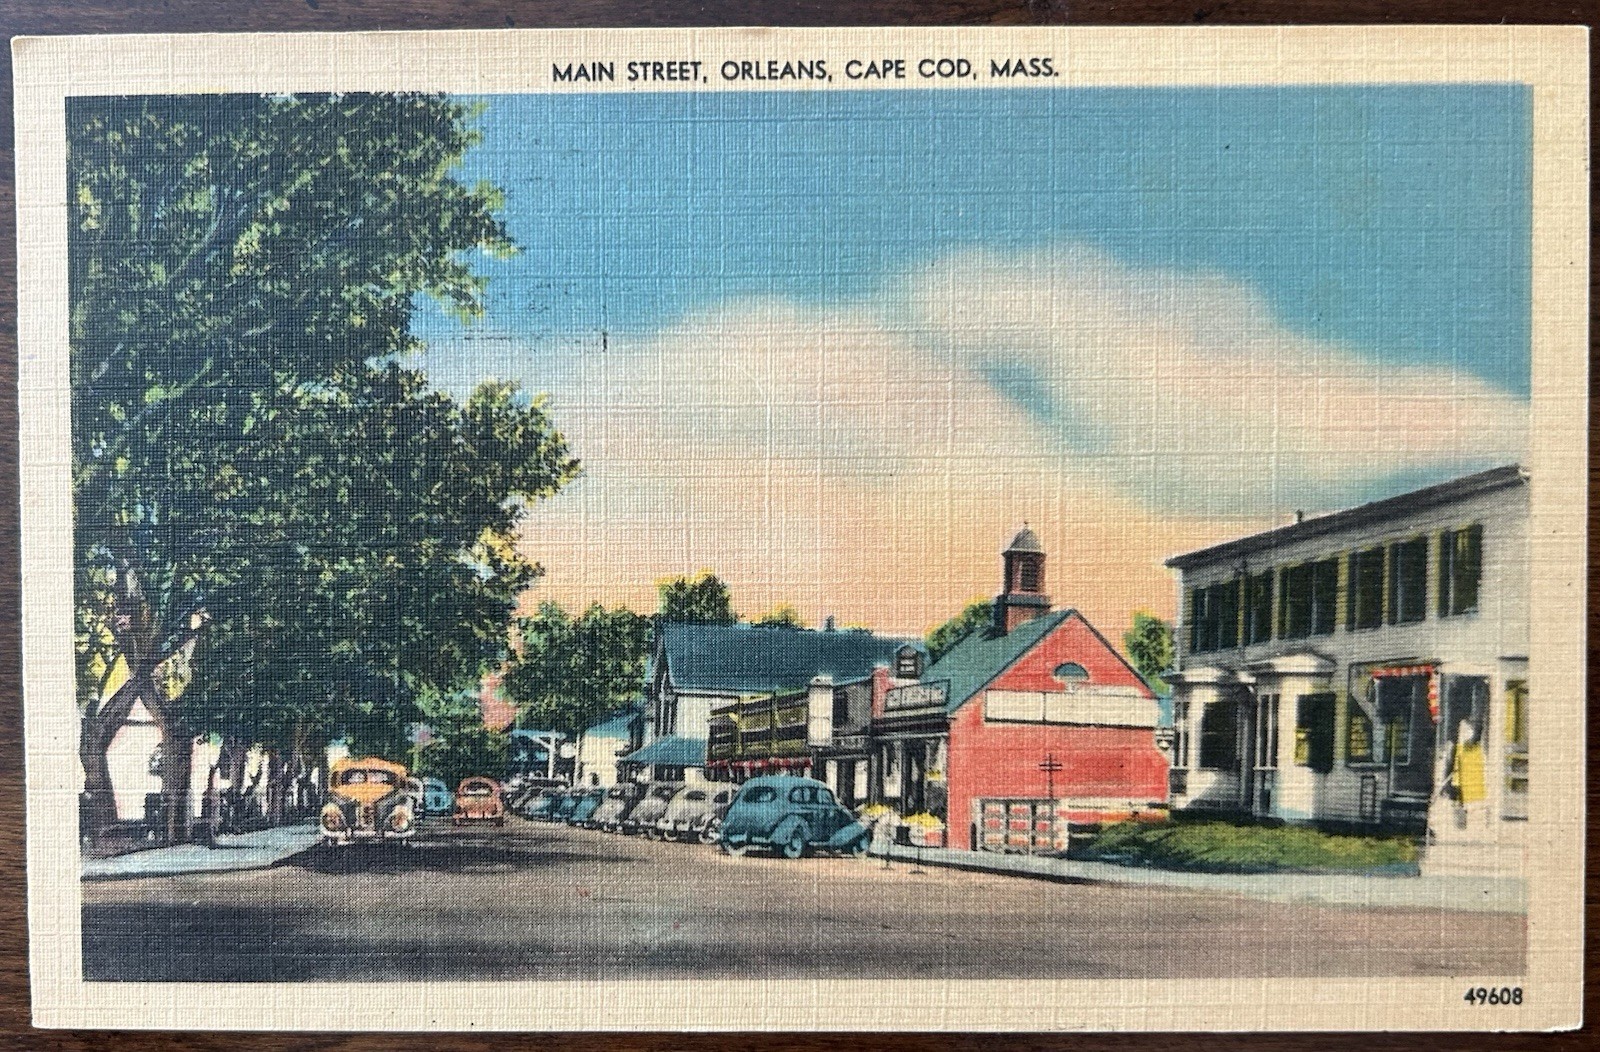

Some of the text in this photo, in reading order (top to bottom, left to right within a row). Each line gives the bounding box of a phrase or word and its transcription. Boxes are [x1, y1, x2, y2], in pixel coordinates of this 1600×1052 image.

[552, 57, 1060, 84] MAIN STREET, ORLEANS, CAPE COD, MASS.
[1464, 987, 1523, 1005] 49608
